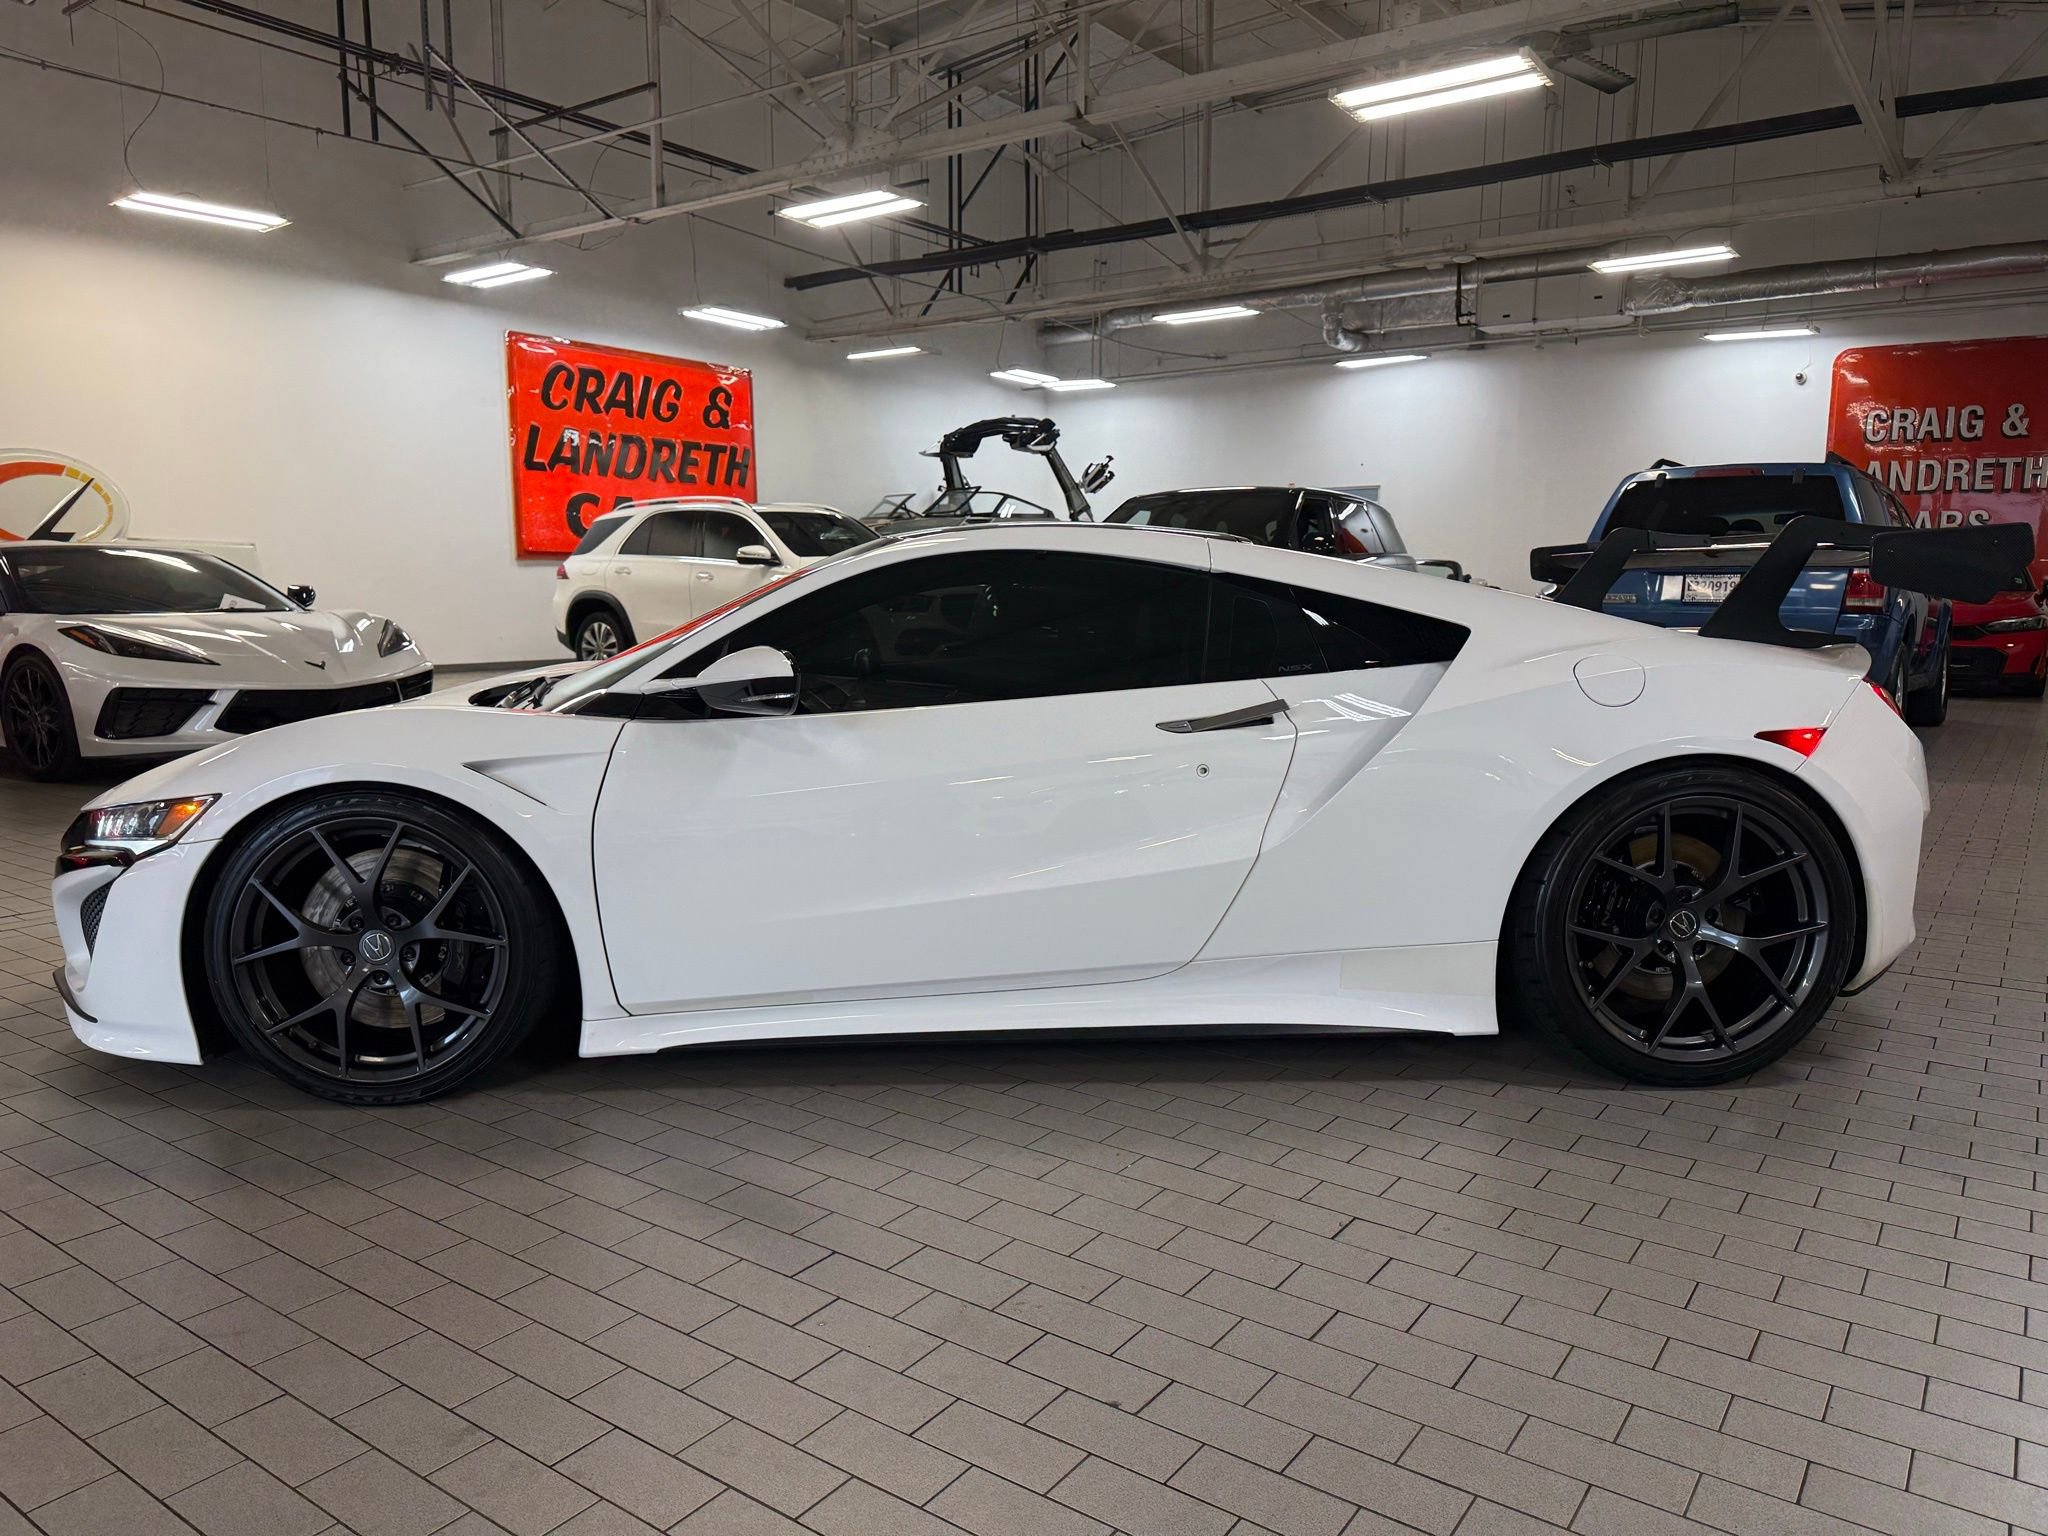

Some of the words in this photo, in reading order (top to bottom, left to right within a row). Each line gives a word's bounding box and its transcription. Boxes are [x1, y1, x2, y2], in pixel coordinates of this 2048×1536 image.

[540, 363, 683, 423] CRAIG
[702, 385, 733, 429] &
[1865, 405, 1985, 443] CRAIG
[2002, 403, 2030, 438] &
[523, 423, 750, 488] LANDRETH
[1865, 456, 2048, 493] ANDRETH
[1914, 509, 1991, 530] ARS
[1278, 663, 1312, 672] NSX
